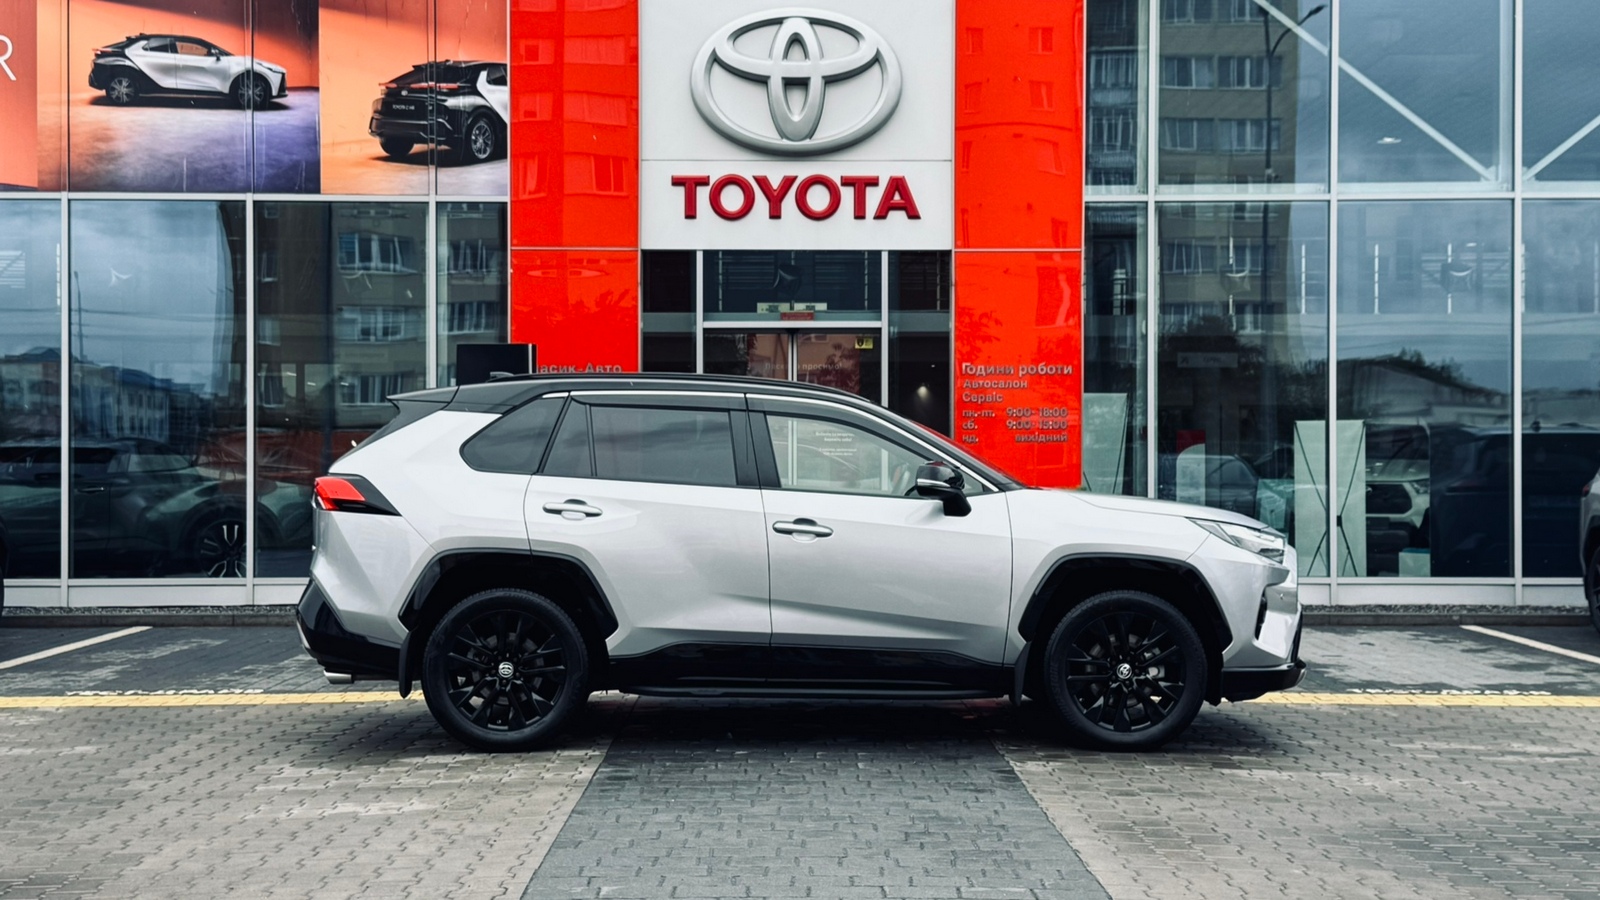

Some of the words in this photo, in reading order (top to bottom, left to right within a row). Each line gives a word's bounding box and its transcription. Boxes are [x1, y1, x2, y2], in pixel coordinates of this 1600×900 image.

[671, 173, 921, 221] TOYOTA
[537, 362, 622, 374] асик-Авто
[962, 362, 1014, 376] Години
[1018, 362, 1073, 377] роботи
[963, 379, 1028, 389] Автосалон
[962, 391, 1004, 404] Сервіс
[1015, 432, 1068, 443] вихідний
